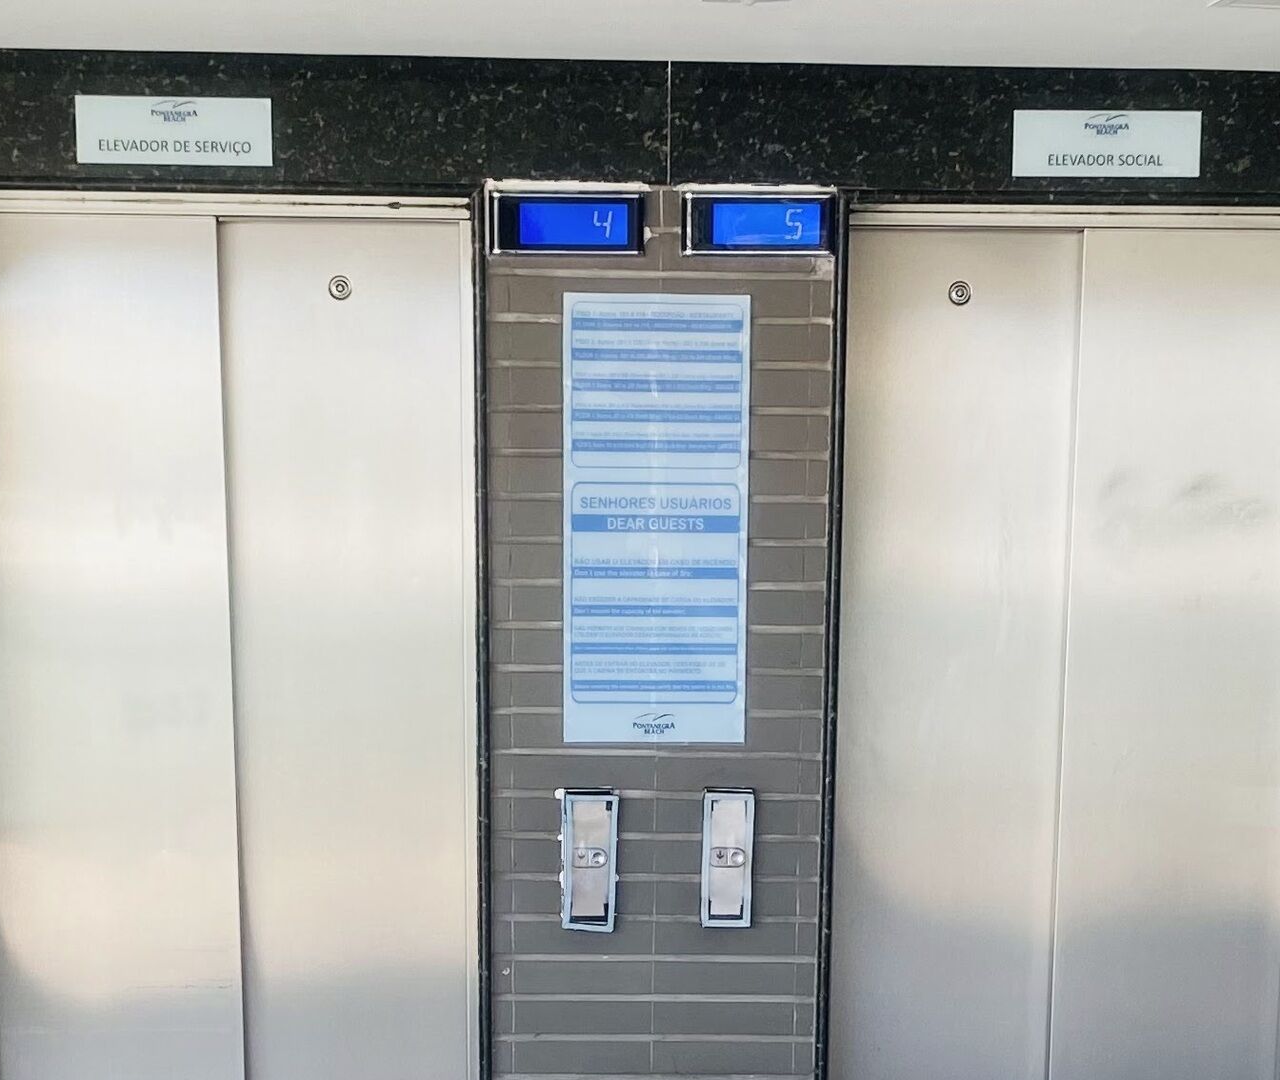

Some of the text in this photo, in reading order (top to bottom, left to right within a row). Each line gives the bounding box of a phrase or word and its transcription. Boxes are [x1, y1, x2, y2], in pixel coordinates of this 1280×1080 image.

[98, 139, 252, 156] ELEVADOR DE SERVIÇO
[1048, 154, 1162, 166] ELEVADOR SOCIAL
[593, 210, 613, 238] 4
[785, 208, 804, 240] 5
[580, 495, 732, 511] SENHORES USUÁRIOS
[607, 517, 705, 531] DEAR GUESTS
[632, 722, 676, 731] PONTANEGRA
